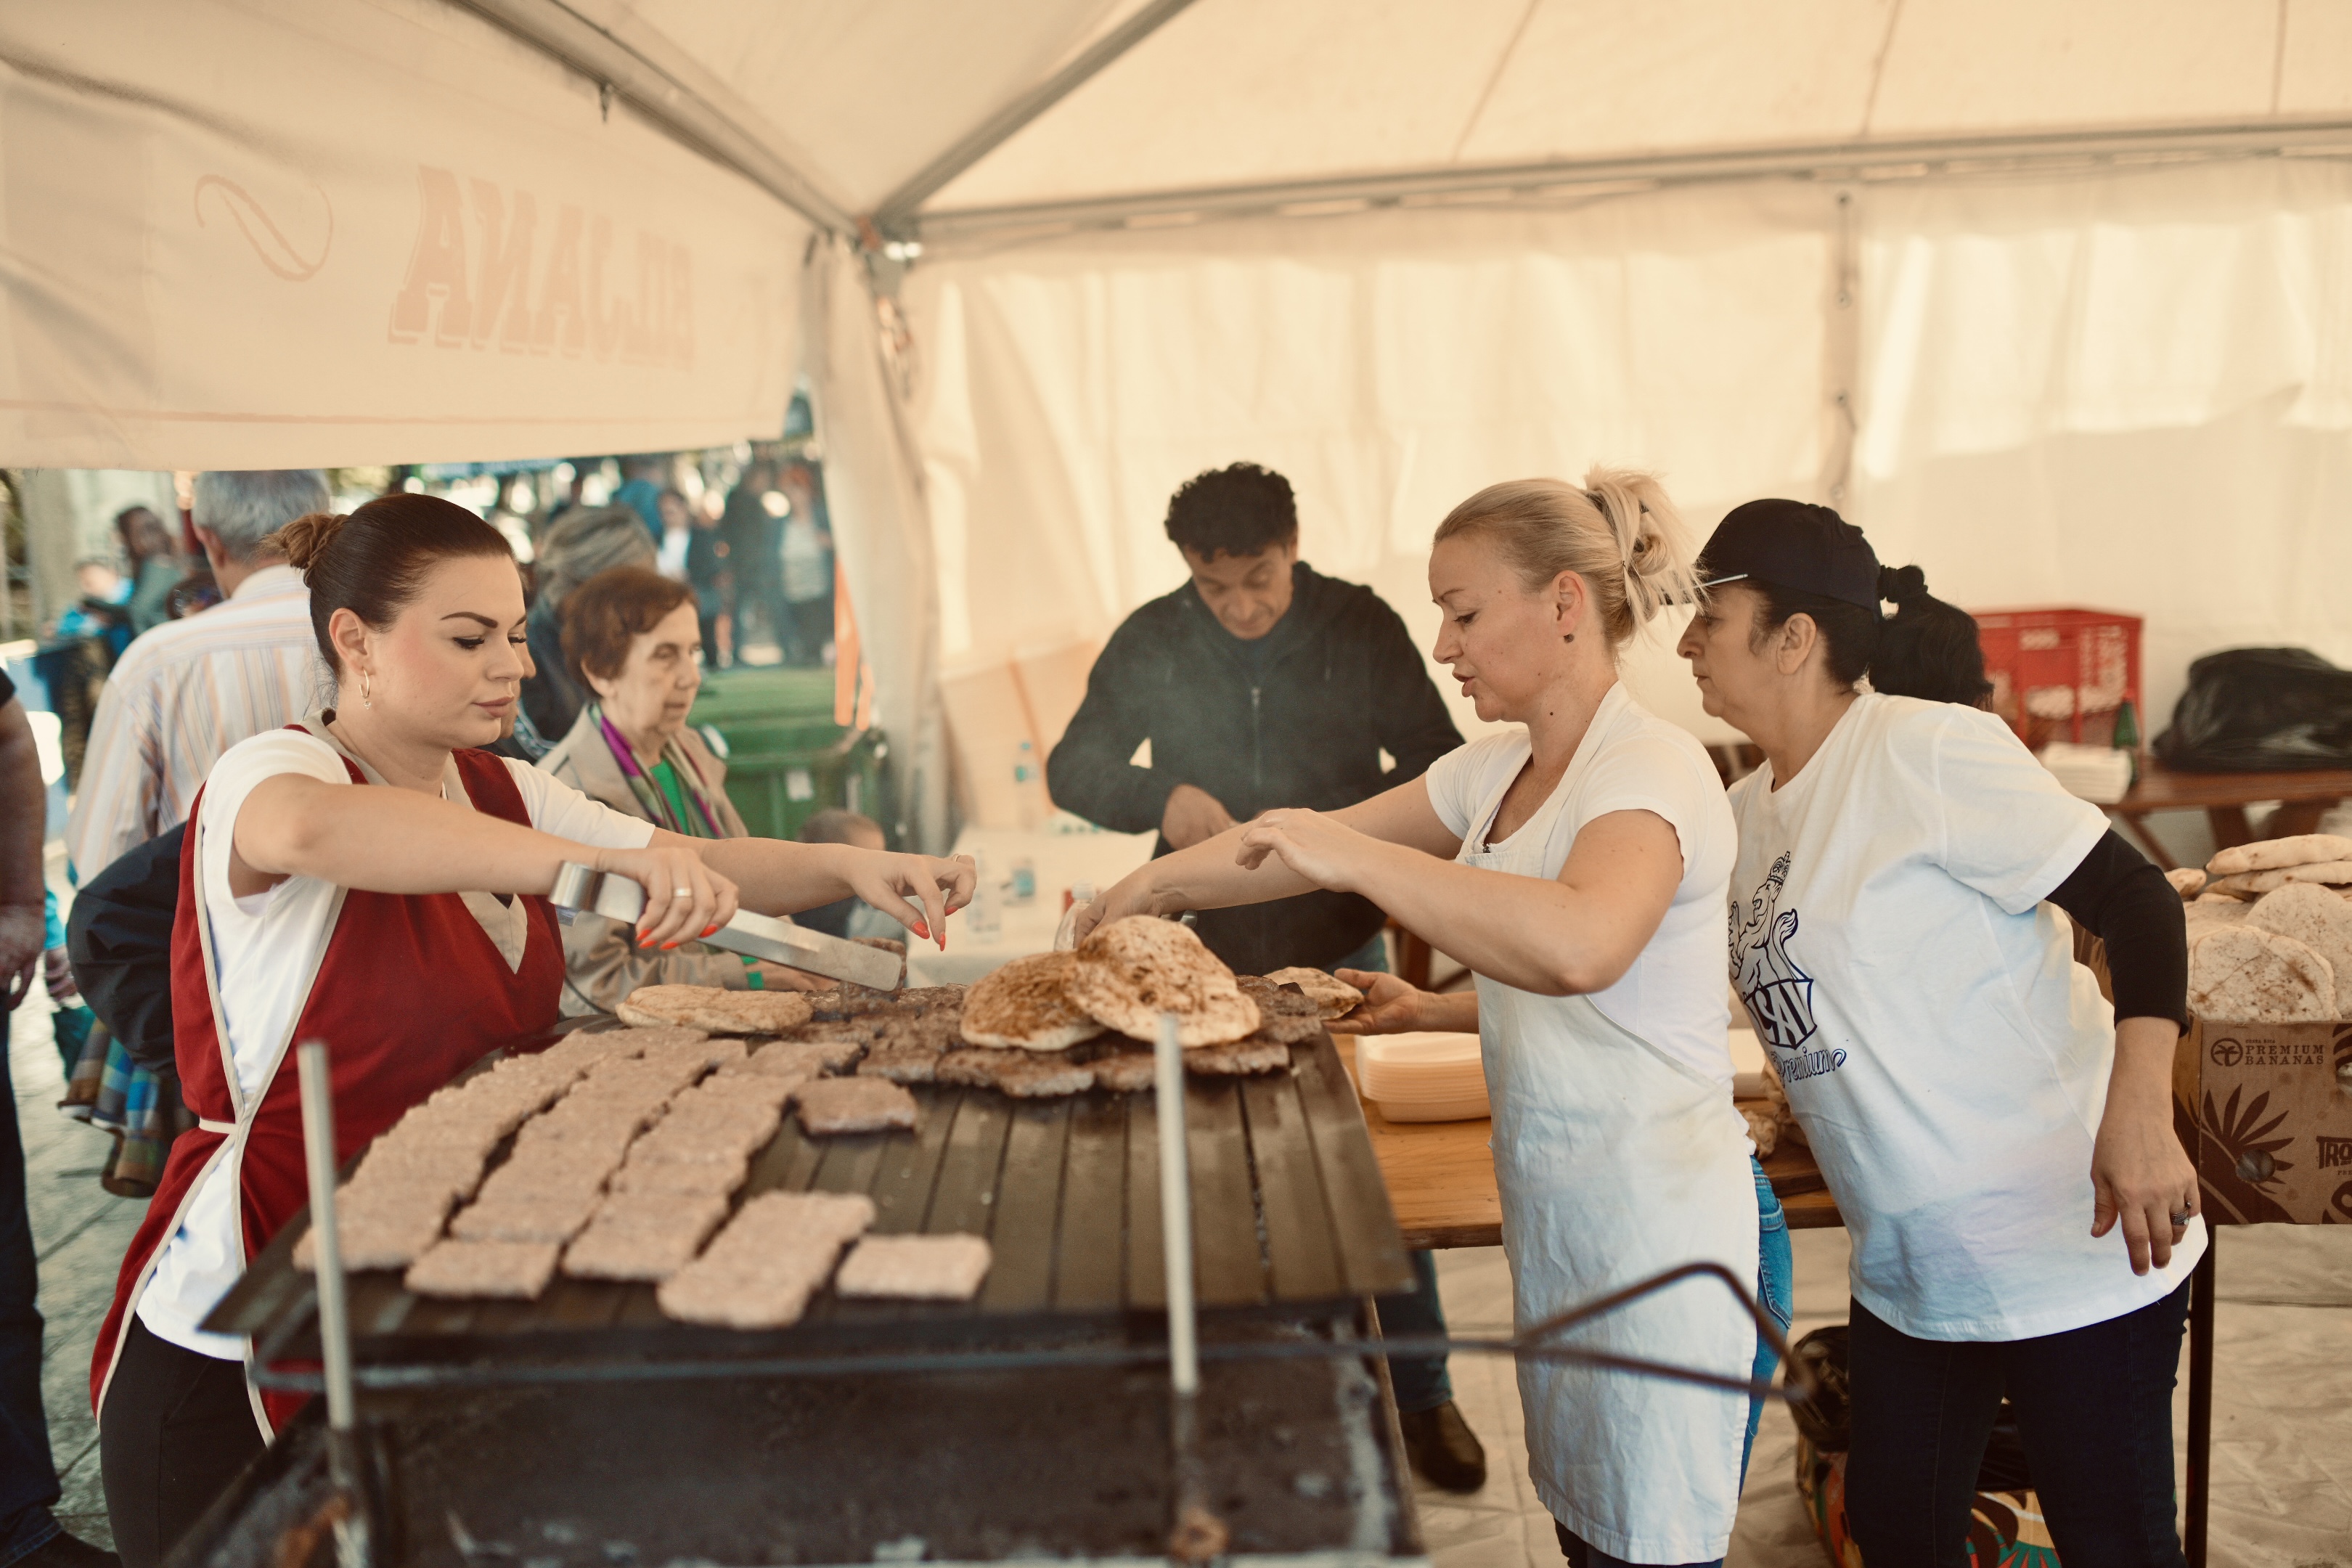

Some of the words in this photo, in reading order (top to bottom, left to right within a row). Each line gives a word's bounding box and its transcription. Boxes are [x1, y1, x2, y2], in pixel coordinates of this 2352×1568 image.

[2245, 1045, 2324, 1055] PREMIUM
[2245, 1055, 2324, 1066] BANANAS
[1771, 1047, 1847, 1088] Premium
